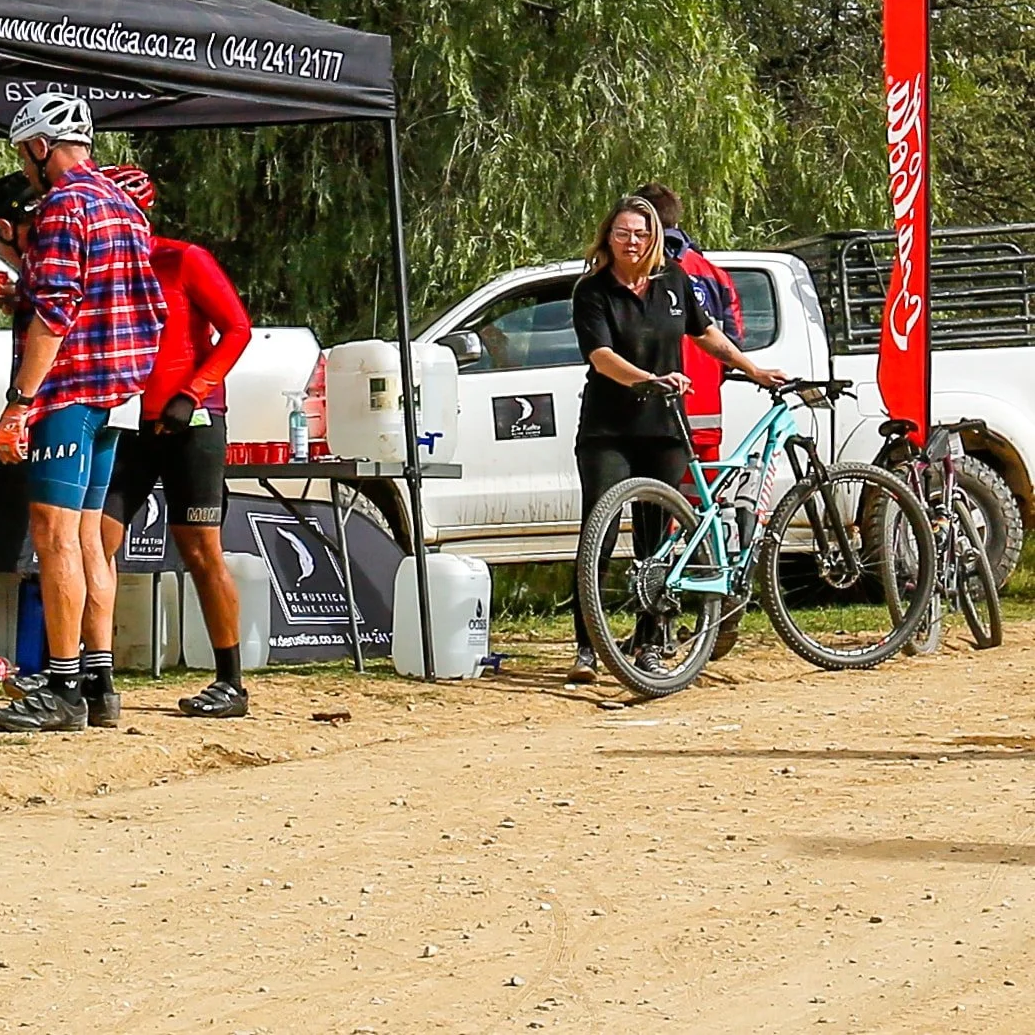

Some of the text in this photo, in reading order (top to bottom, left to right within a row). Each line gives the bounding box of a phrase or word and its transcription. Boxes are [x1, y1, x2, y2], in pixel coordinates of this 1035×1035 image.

[222, 35, 257, 69] 044
[262, 40, 294, 75] 241
[300, 45, 344, 81] 2177
